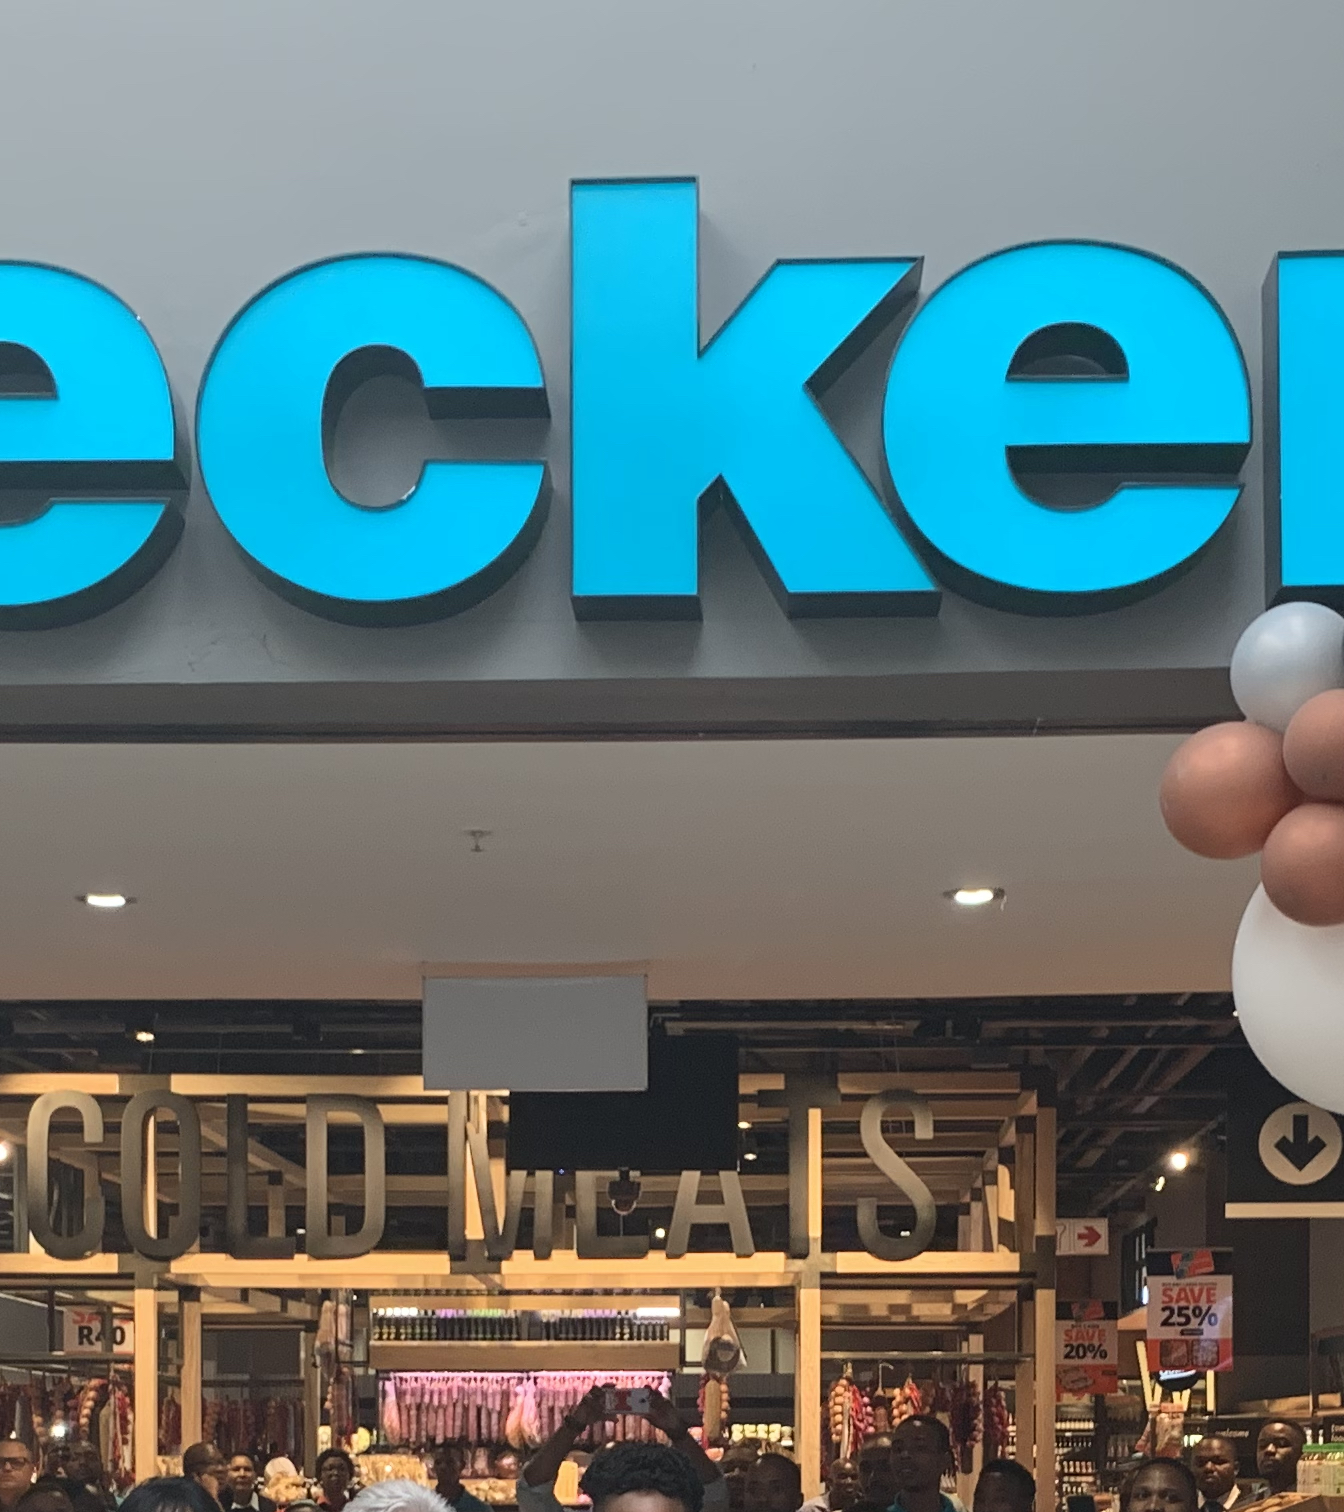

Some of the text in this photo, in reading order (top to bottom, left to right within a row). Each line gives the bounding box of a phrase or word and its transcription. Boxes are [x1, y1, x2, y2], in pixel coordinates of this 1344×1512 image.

[26, 1089, 386, 1261] COLD
[1161, 1287, 1217, 1305] SAVE
[1160, 1305, 1218, 1327] 25%
[1063, 1328, 1106, 1343] SAVE
[1063, 1343, 1107, 1360] 20%
